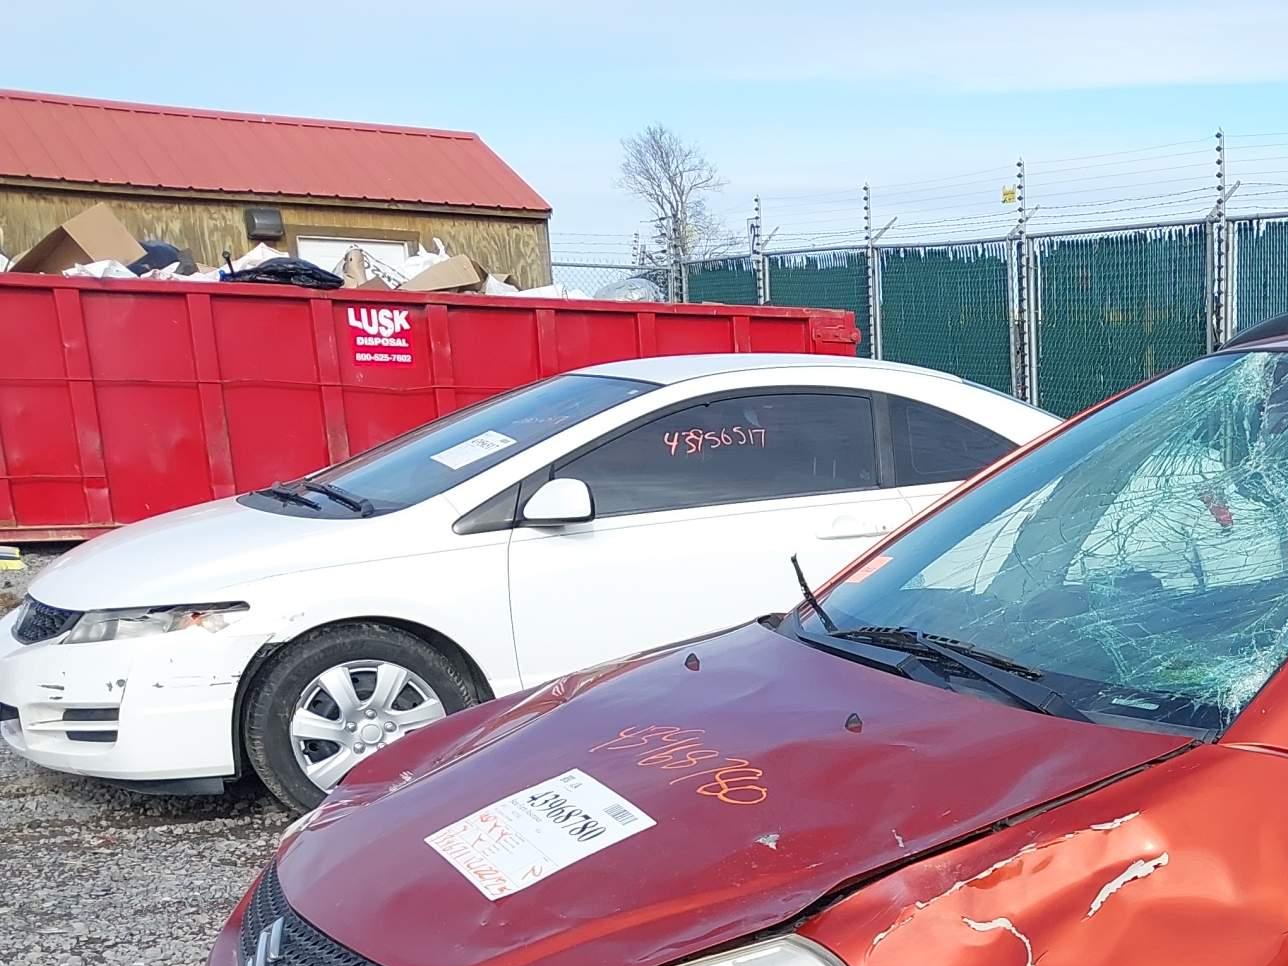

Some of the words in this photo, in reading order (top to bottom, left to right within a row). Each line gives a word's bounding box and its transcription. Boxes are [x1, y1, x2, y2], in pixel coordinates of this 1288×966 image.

[347, 307, 411, 337] LUSK
[356, 336, 409, 347] DISPOSAL
[525, 789, 607, 842] 43968780
